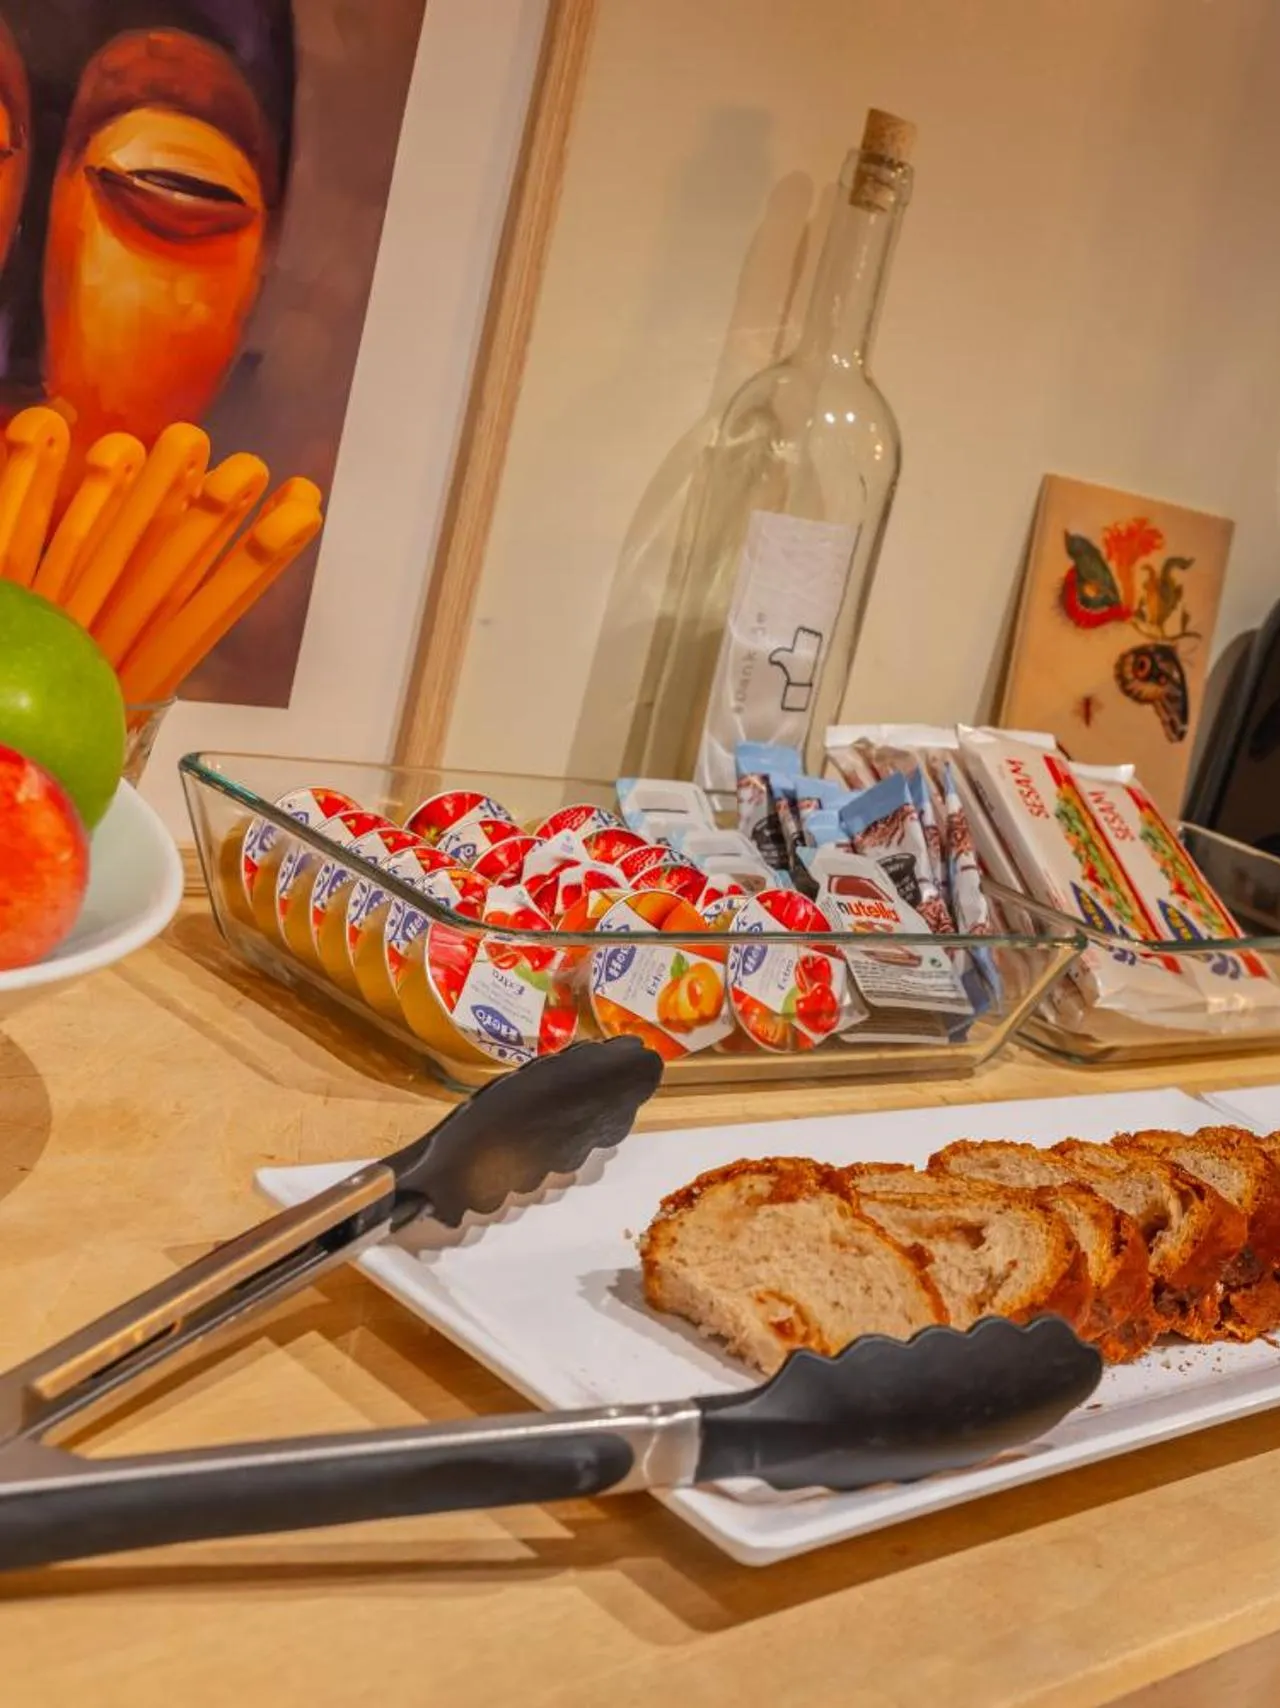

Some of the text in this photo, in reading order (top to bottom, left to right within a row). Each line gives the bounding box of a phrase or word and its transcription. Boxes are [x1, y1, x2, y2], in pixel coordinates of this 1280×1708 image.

[1005, 758, 1050, 819] SESAM
[1088, 790, 1136, 841] SESAM
[837, 901, 900, 923] nutella
[492, 968, 525, 995] Extra
[474, 1008, 519, 1041] Hero
